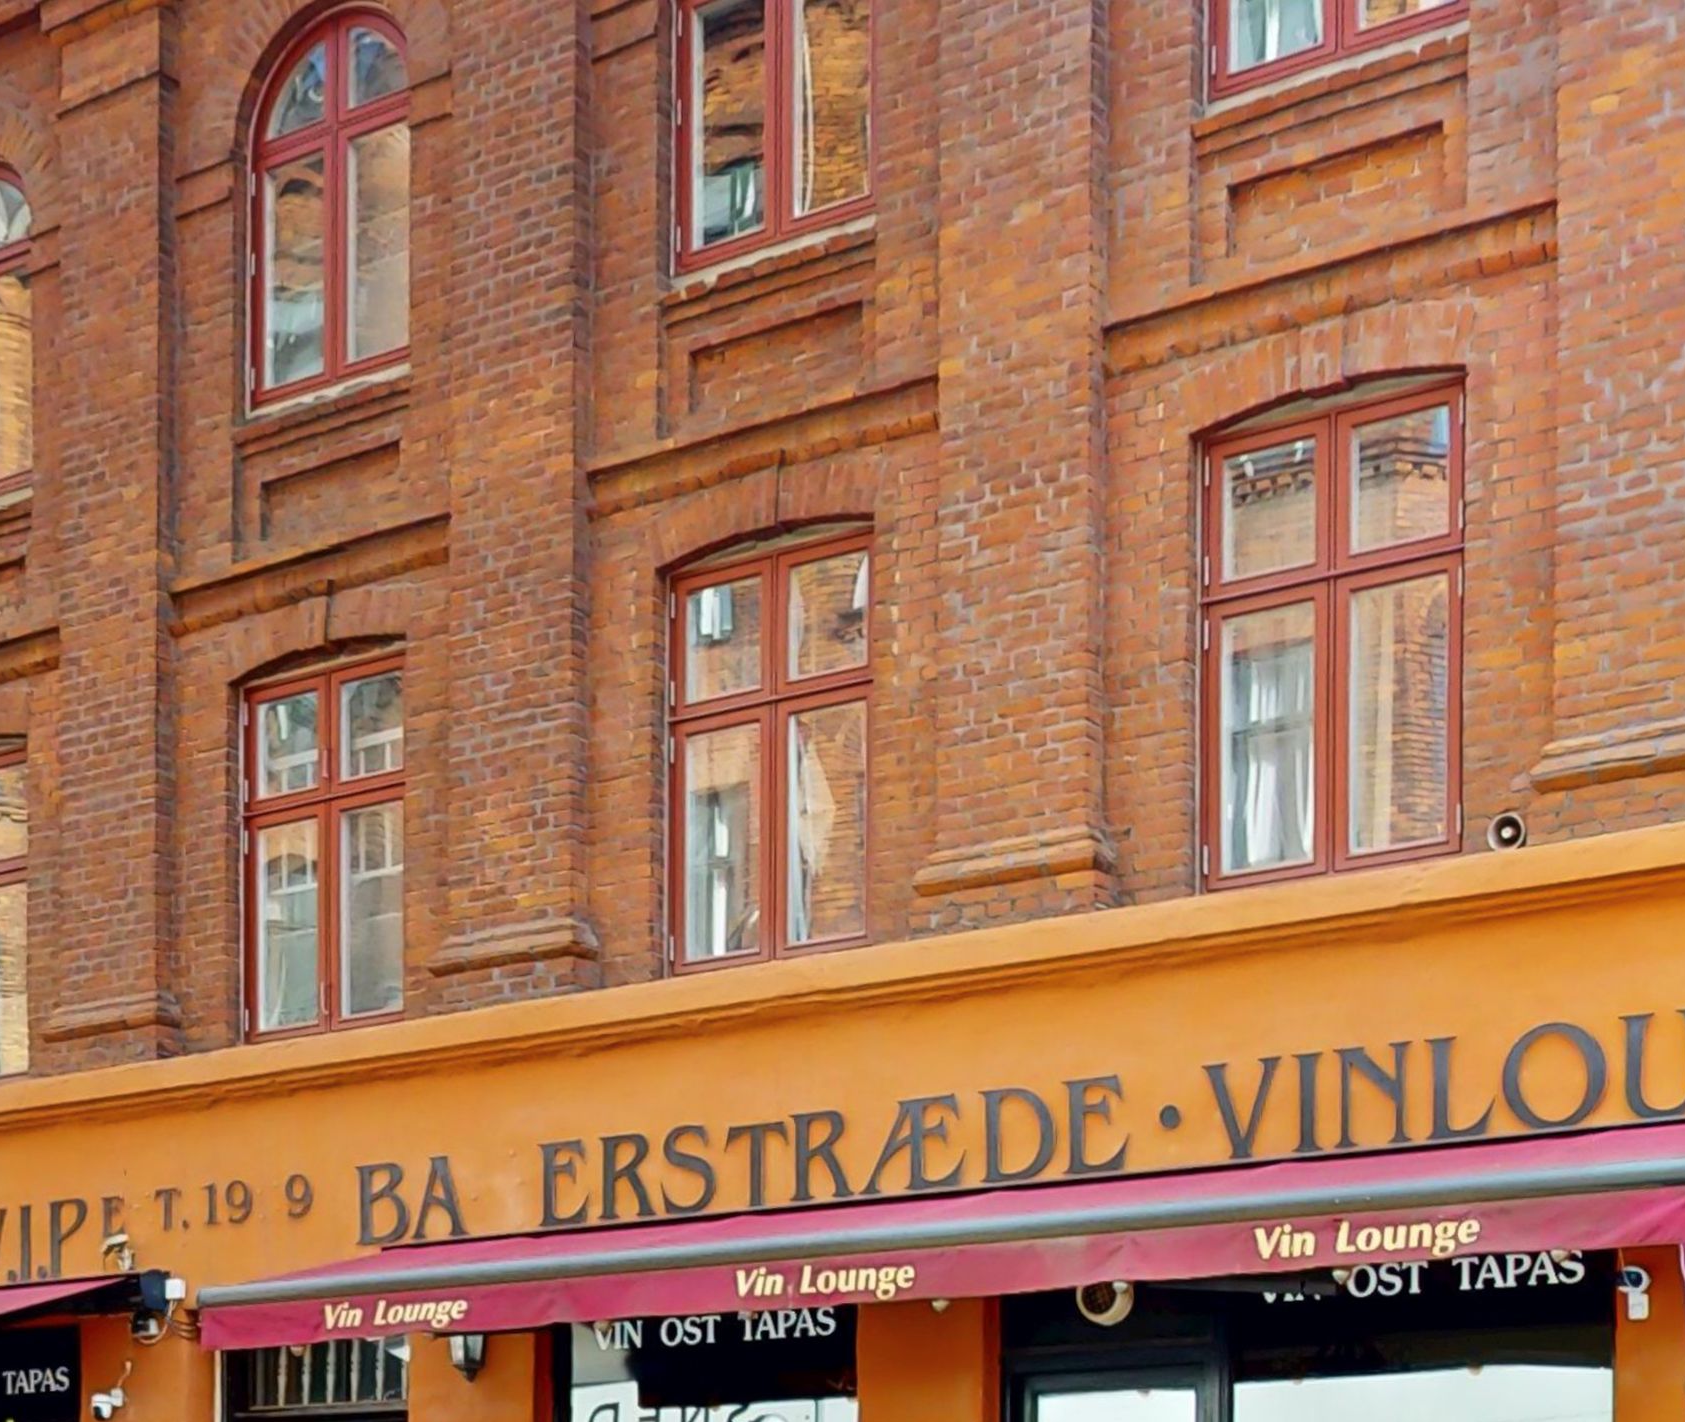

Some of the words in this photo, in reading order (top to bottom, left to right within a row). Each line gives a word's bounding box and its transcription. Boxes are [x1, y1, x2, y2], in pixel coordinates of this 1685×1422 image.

[323, 1301, 363, 1330] Vin
[373, 1299, 469, 1329] Lounge
[735, 1267, 784, 1298] Vin
[800, 1264, 915, 1300] Lounge
[1253, 1223, 1315, 1260] Vin
[1335, 1218, 1481, 1257] Lounge
[1345, 1260, 1429, 1299] OST
[1452, 1249, 1586, 1291] TAPAS
[593, 1320, 643, 1351] VIN
[659, 1314, 722, 1347] OST
[737, 1305, 838, 1342] TAPAS
[2, 1366, 70, 1395] TAPAS
